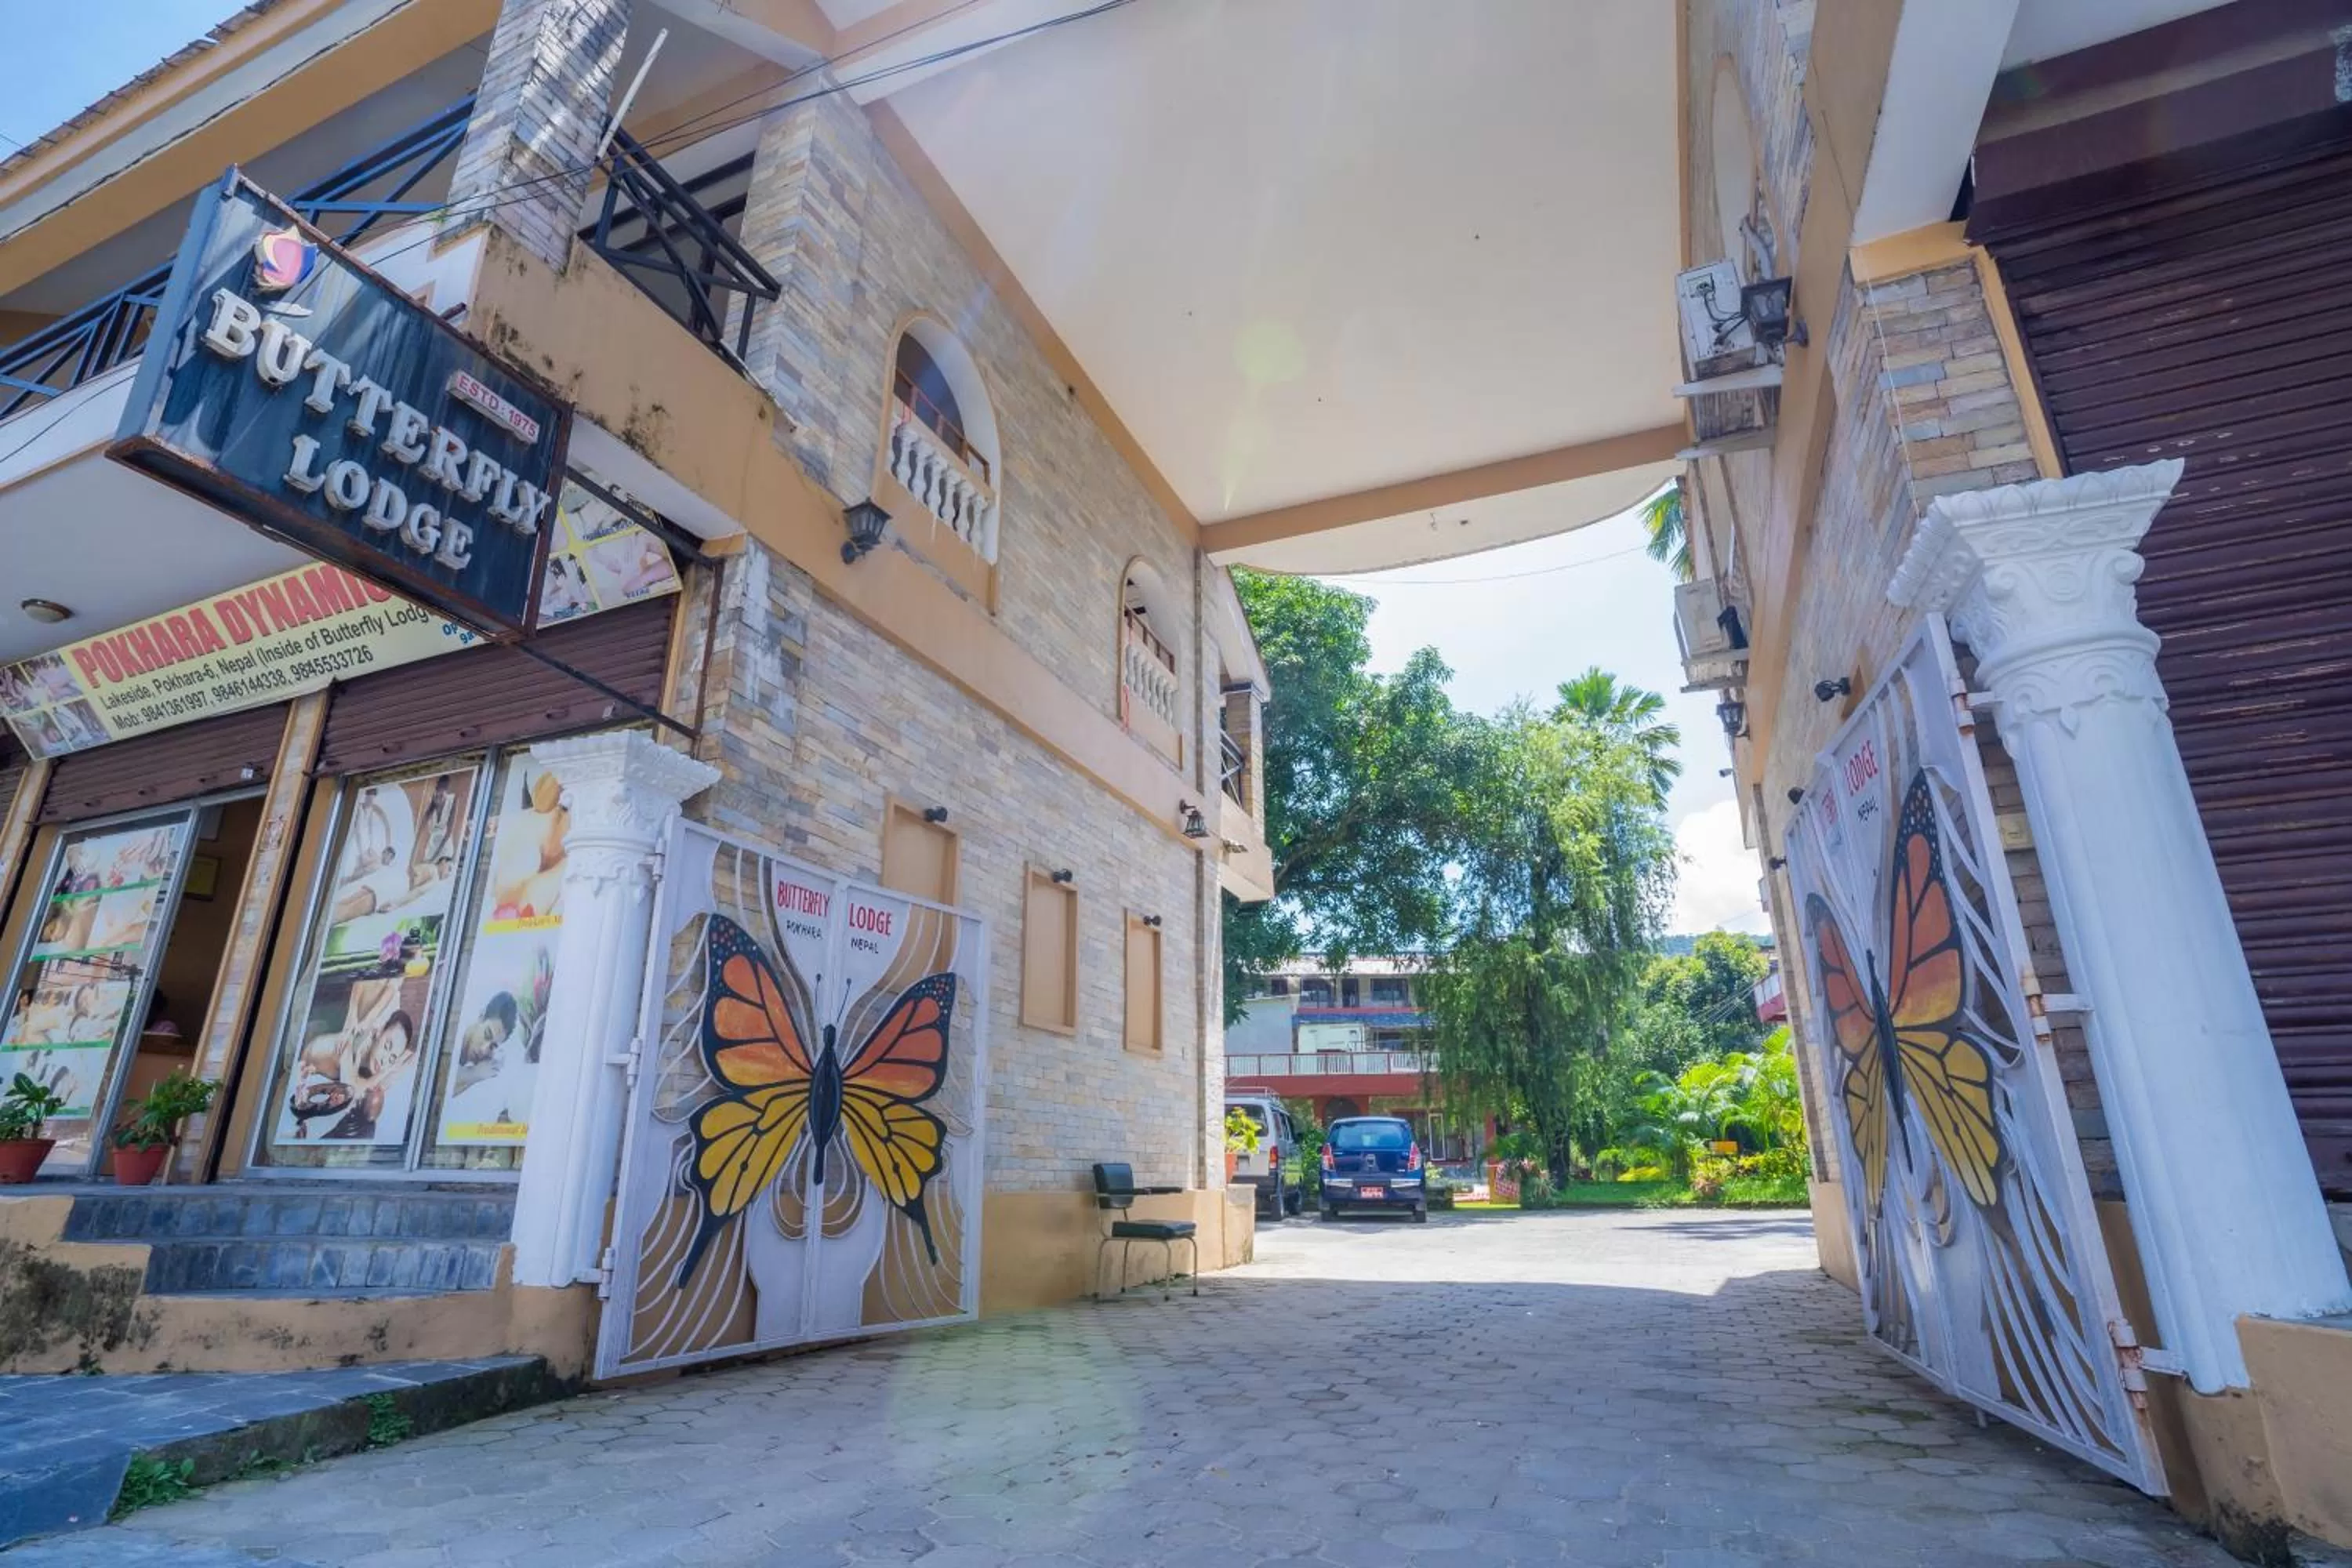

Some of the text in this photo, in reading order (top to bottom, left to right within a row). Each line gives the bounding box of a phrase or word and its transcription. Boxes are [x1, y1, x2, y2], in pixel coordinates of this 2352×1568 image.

[201, 287, 552, 535] BUTTERFLY
[508, 408, 537, 437] 1975
[283, 434, 474, 572] LODGE
[71, 608, 227, 689] POKHARA
[99, 684, 156, 710] Lakeside,
[216, 650, 257, 675] Nepal
[256, 638, 303, 667] (Inside
[304, 631, 321, 651] of
[319, 614, 385, 646] Butterfly
[383, 603, 430, 627] Lodg
[111, 712, 143, 730] Mob:
[777, 879, 893, 937] BUTTERFLY LODGE
[851, 938, 879, 954] NEPAL
